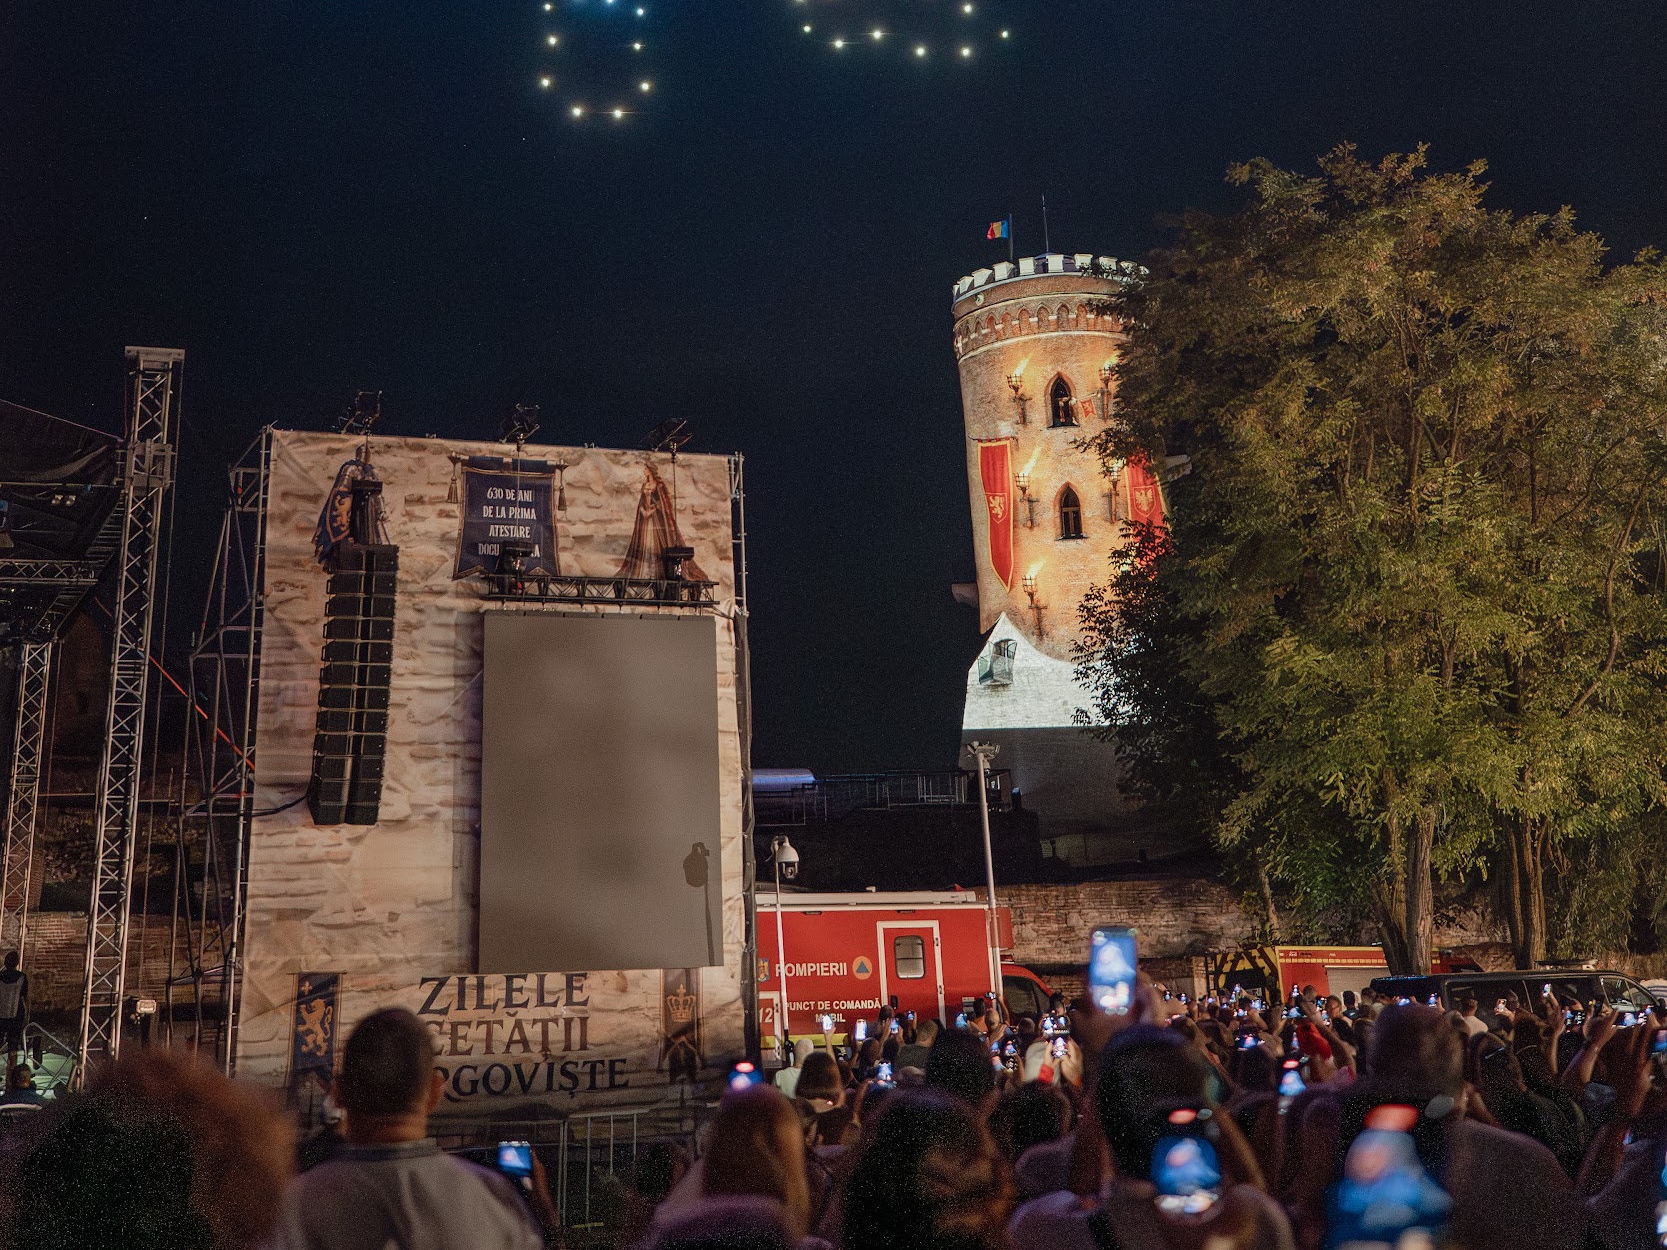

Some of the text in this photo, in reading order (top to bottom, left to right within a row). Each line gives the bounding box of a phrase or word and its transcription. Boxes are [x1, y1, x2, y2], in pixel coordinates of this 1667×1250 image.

[487, 487, 533, 502] 630 DE ANI
[482, 505, 537, 520] DE LA PRIMA
[488, 524, 531, 538] ATESTARE
[417, 972, 591, 1016] ZILELE
[786, 997, 882, 1011] UNCT DE COMANDĂ
[815, 1012, 846, 1023] MBIL
